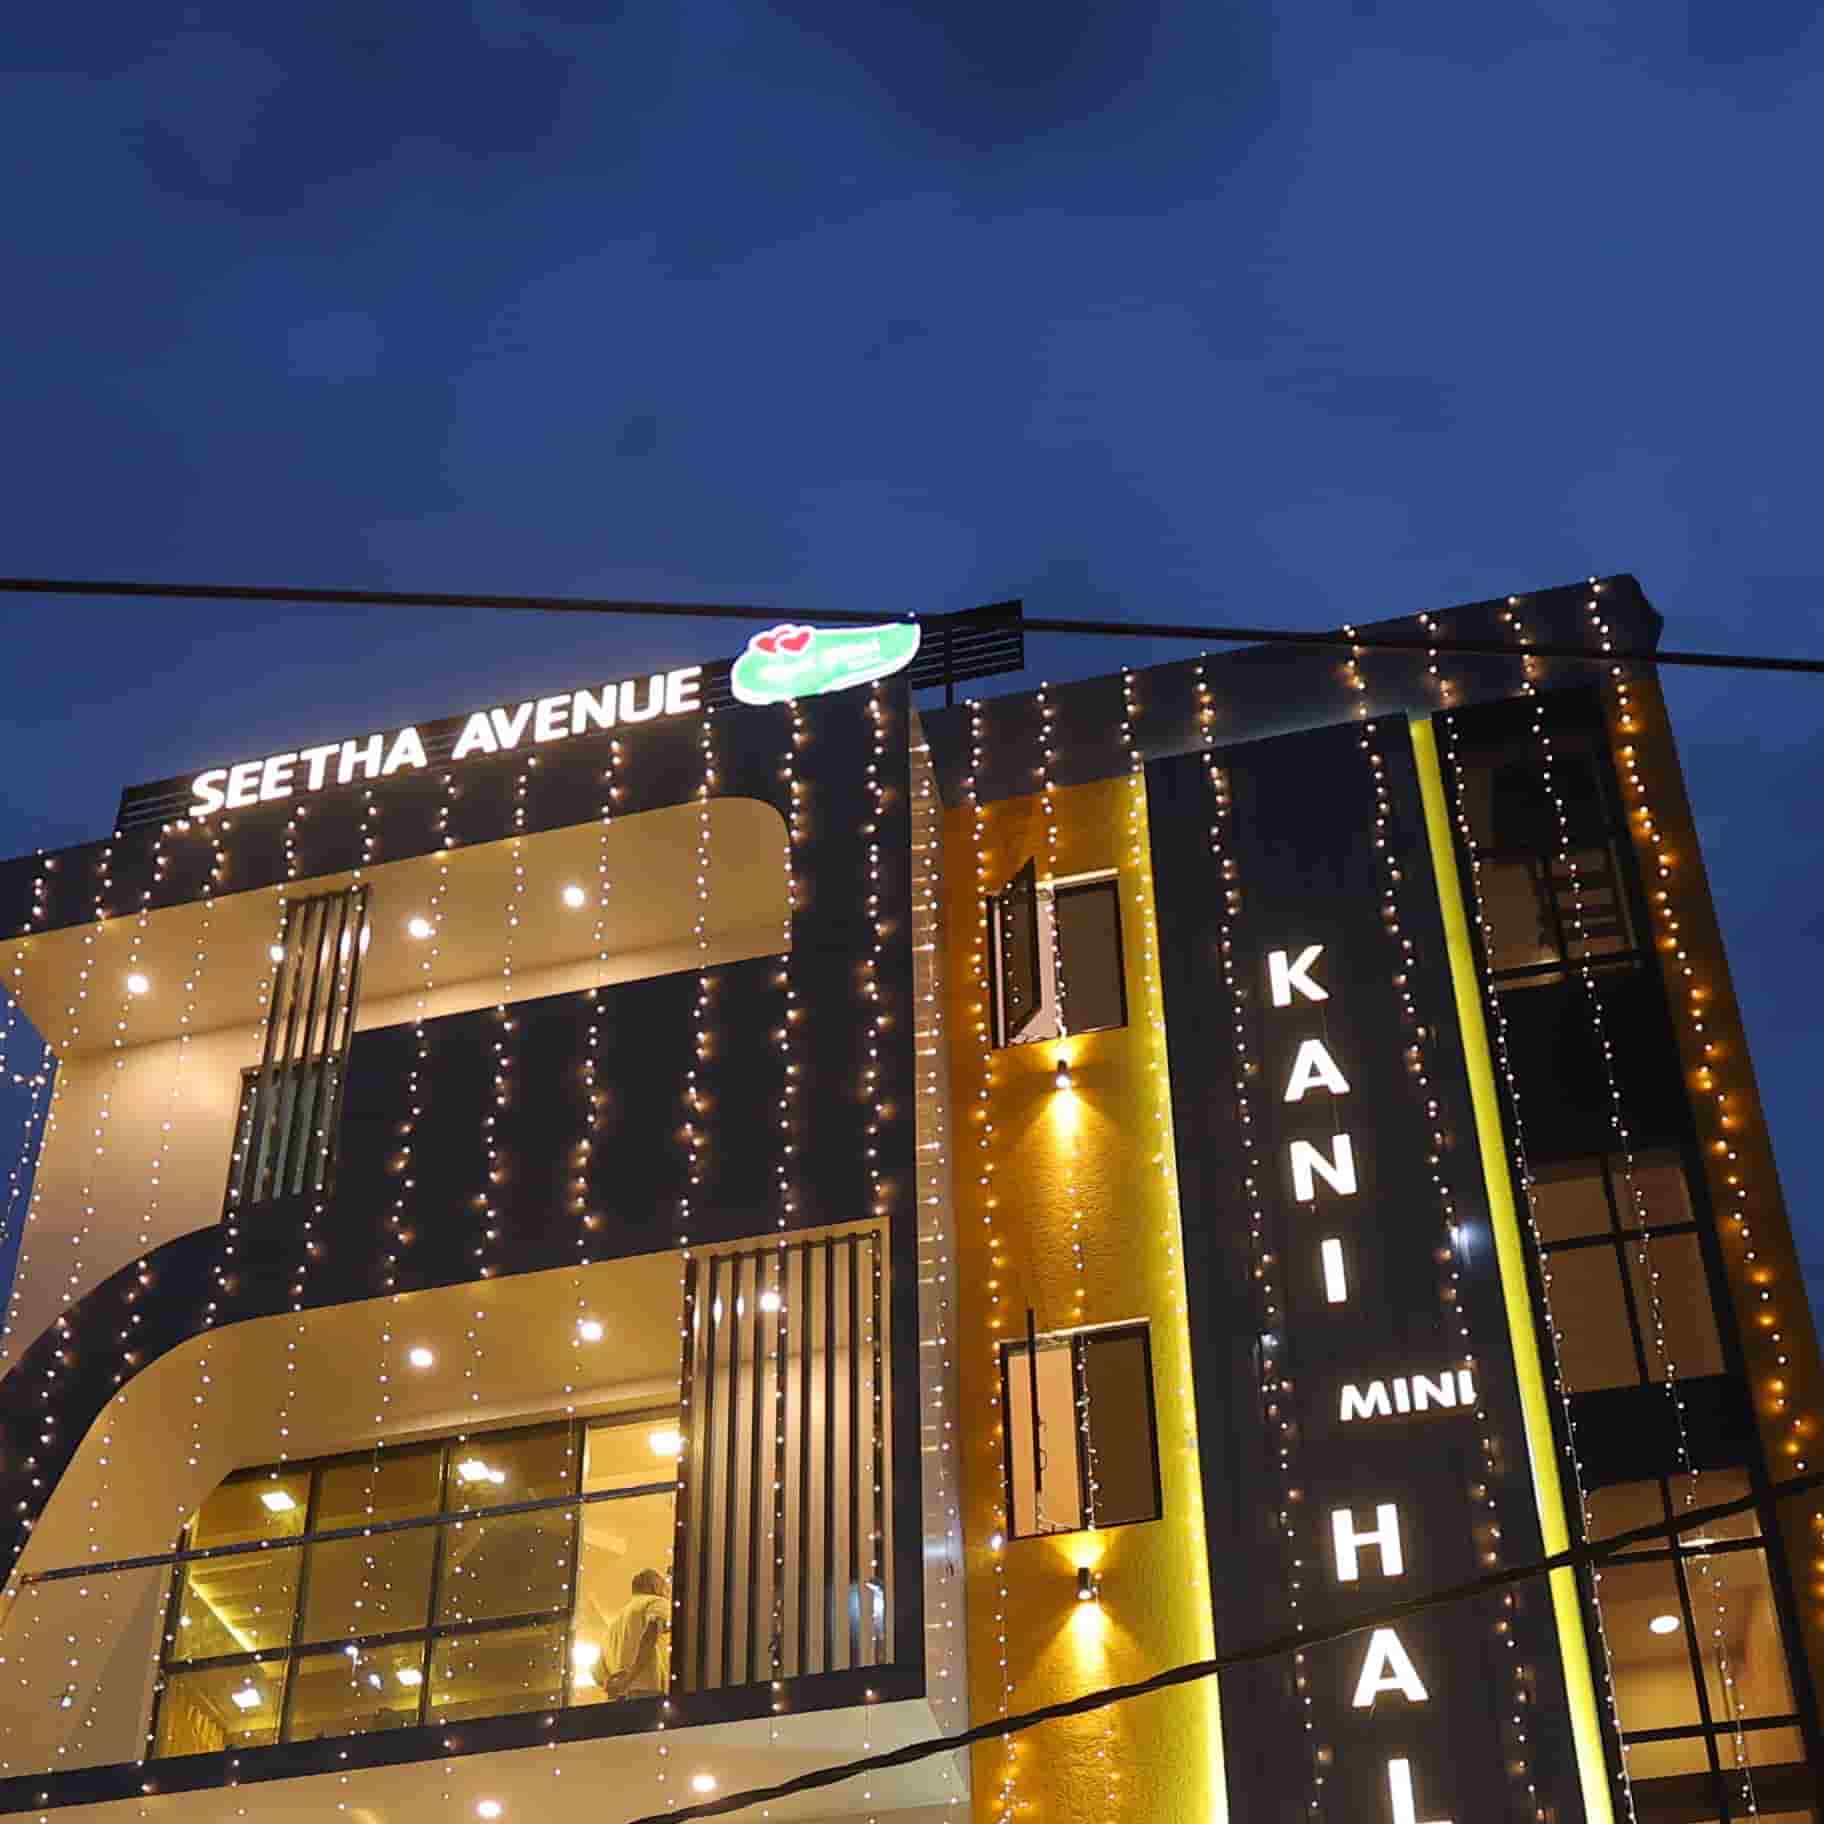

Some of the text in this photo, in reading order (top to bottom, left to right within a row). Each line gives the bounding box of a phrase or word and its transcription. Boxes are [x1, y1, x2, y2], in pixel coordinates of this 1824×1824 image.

[189, 726, 428, 817] SEETHA
[451, 665, 702, 760] AVENUE
[1267, 944, 1358, 1303] KANI
[1339, 1370, 1476, 1421] MINI
